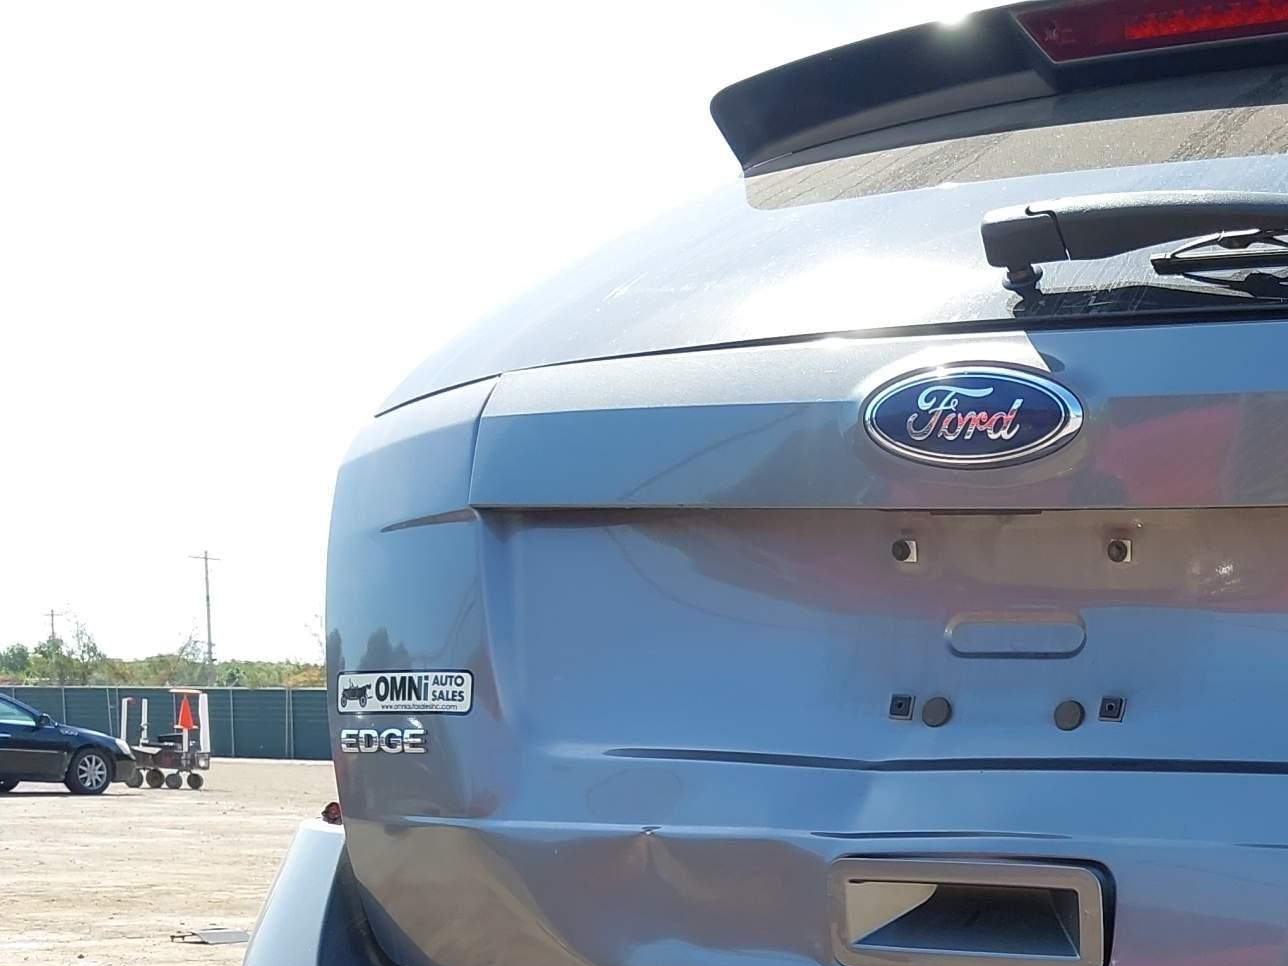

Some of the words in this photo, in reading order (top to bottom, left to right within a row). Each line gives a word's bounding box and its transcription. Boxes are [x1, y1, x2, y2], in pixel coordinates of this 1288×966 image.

[907, 385, 1024, 441] Ford
[432, 675, 465, 686] AUTO
[431, 690, 465, 702] SALES
[340, 728, 427, 754] EDGE
